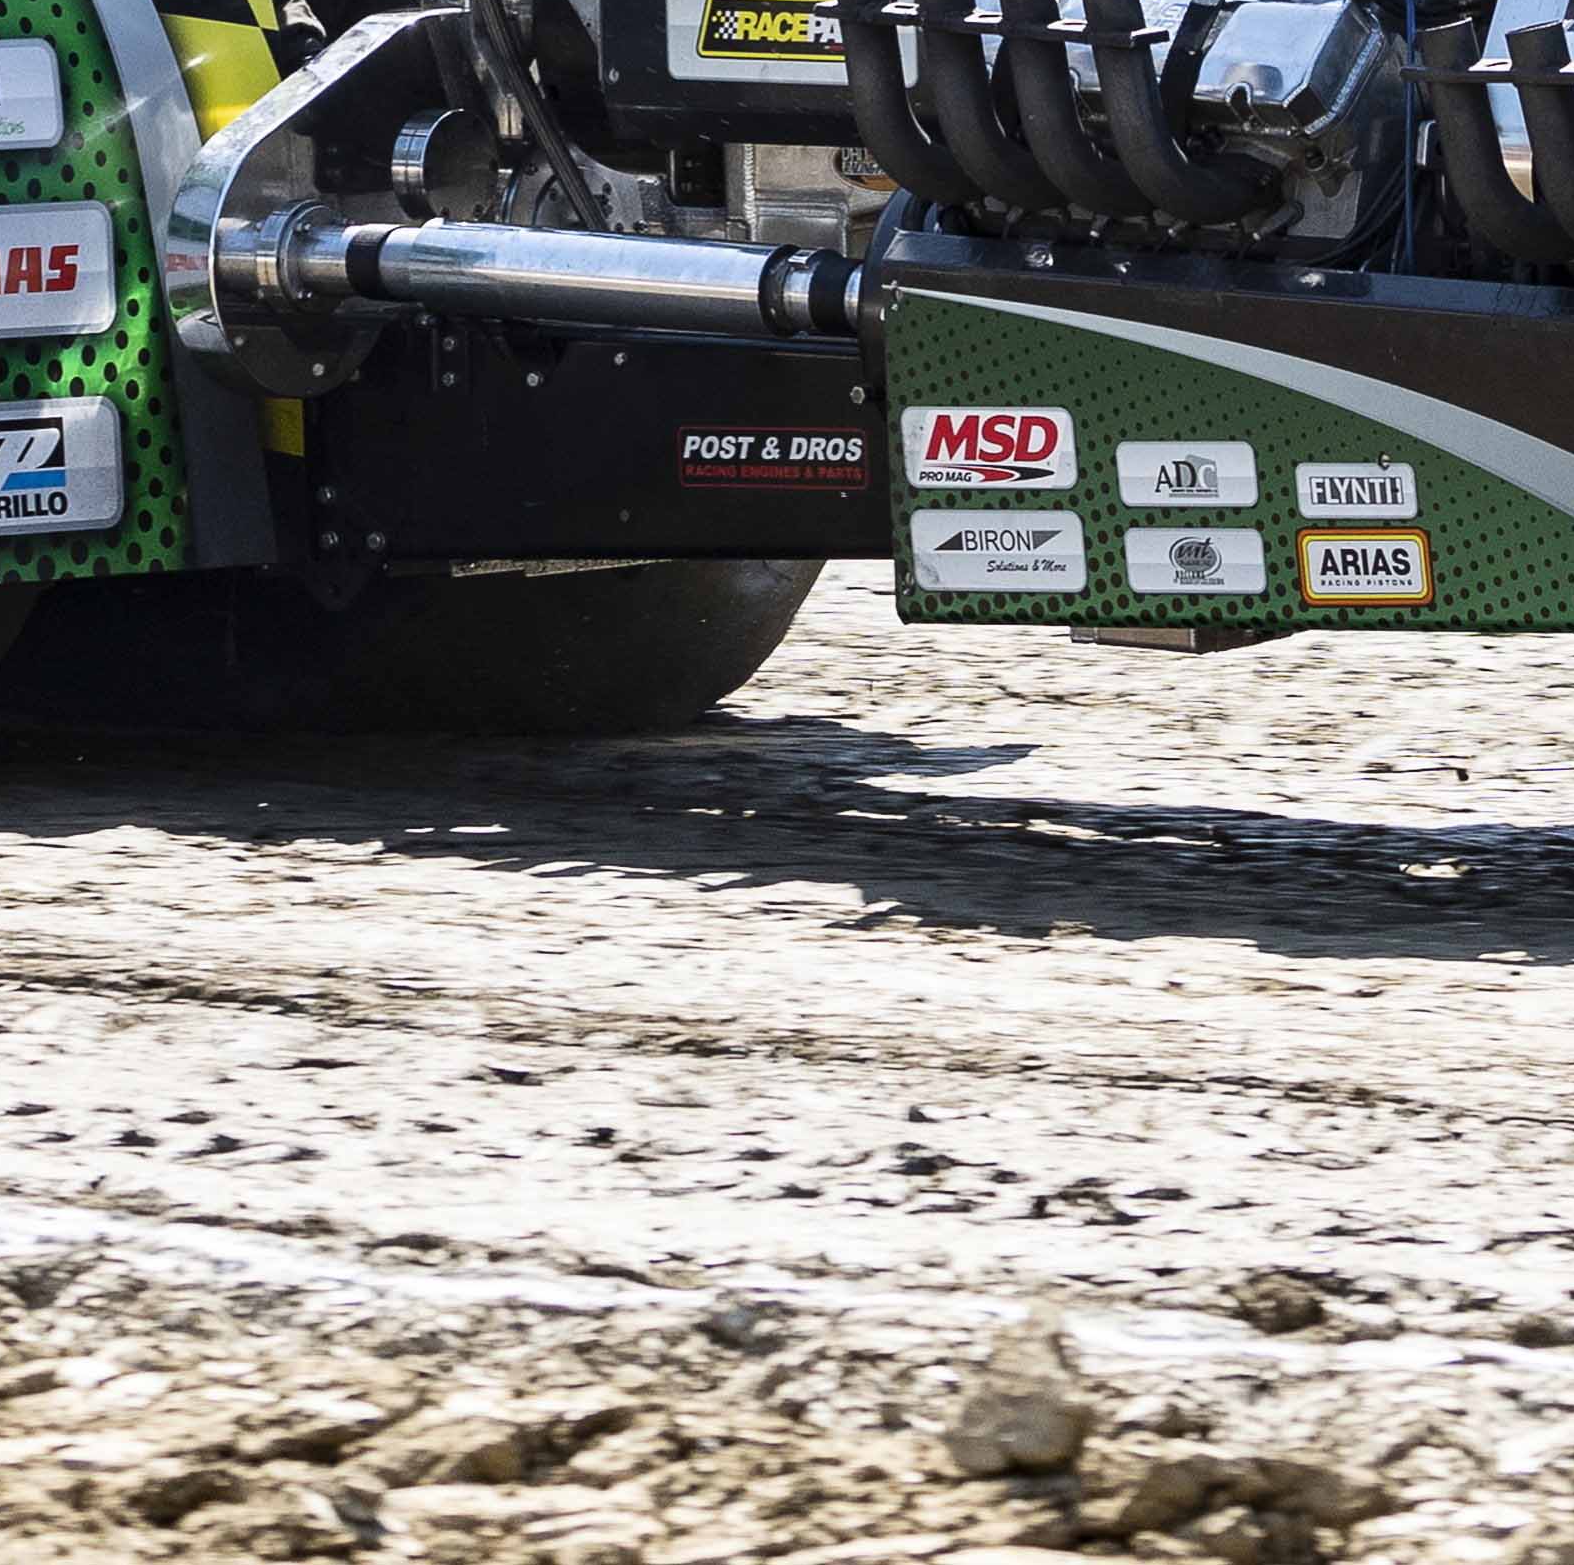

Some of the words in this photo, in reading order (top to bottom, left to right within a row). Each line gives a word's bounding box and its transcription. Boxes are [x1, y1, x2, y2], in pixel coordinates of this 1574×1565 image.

[732, 10, 843, 43] RACEPA
[683, 435, 755, 459] POST
[761, 436, 781, 460] &
[789, 437, 863, 462] DROS
[925, 414, 1059, 463] MSD
[685, 465, 737, 477] RACING
[919, 471, 943, 482] PRO
[945, 471, 972, 483] MAG
[1154, 460, 1218, 493] ADC
[1310, 477, 1404, 505] FLYNTH
[963, 530, 1032, 552] BIRON
[986, 559, 1028, 573] Solutions
[1040, 559, 1067, 572] More
[1320, 547, 1411, 576] ARIAS
